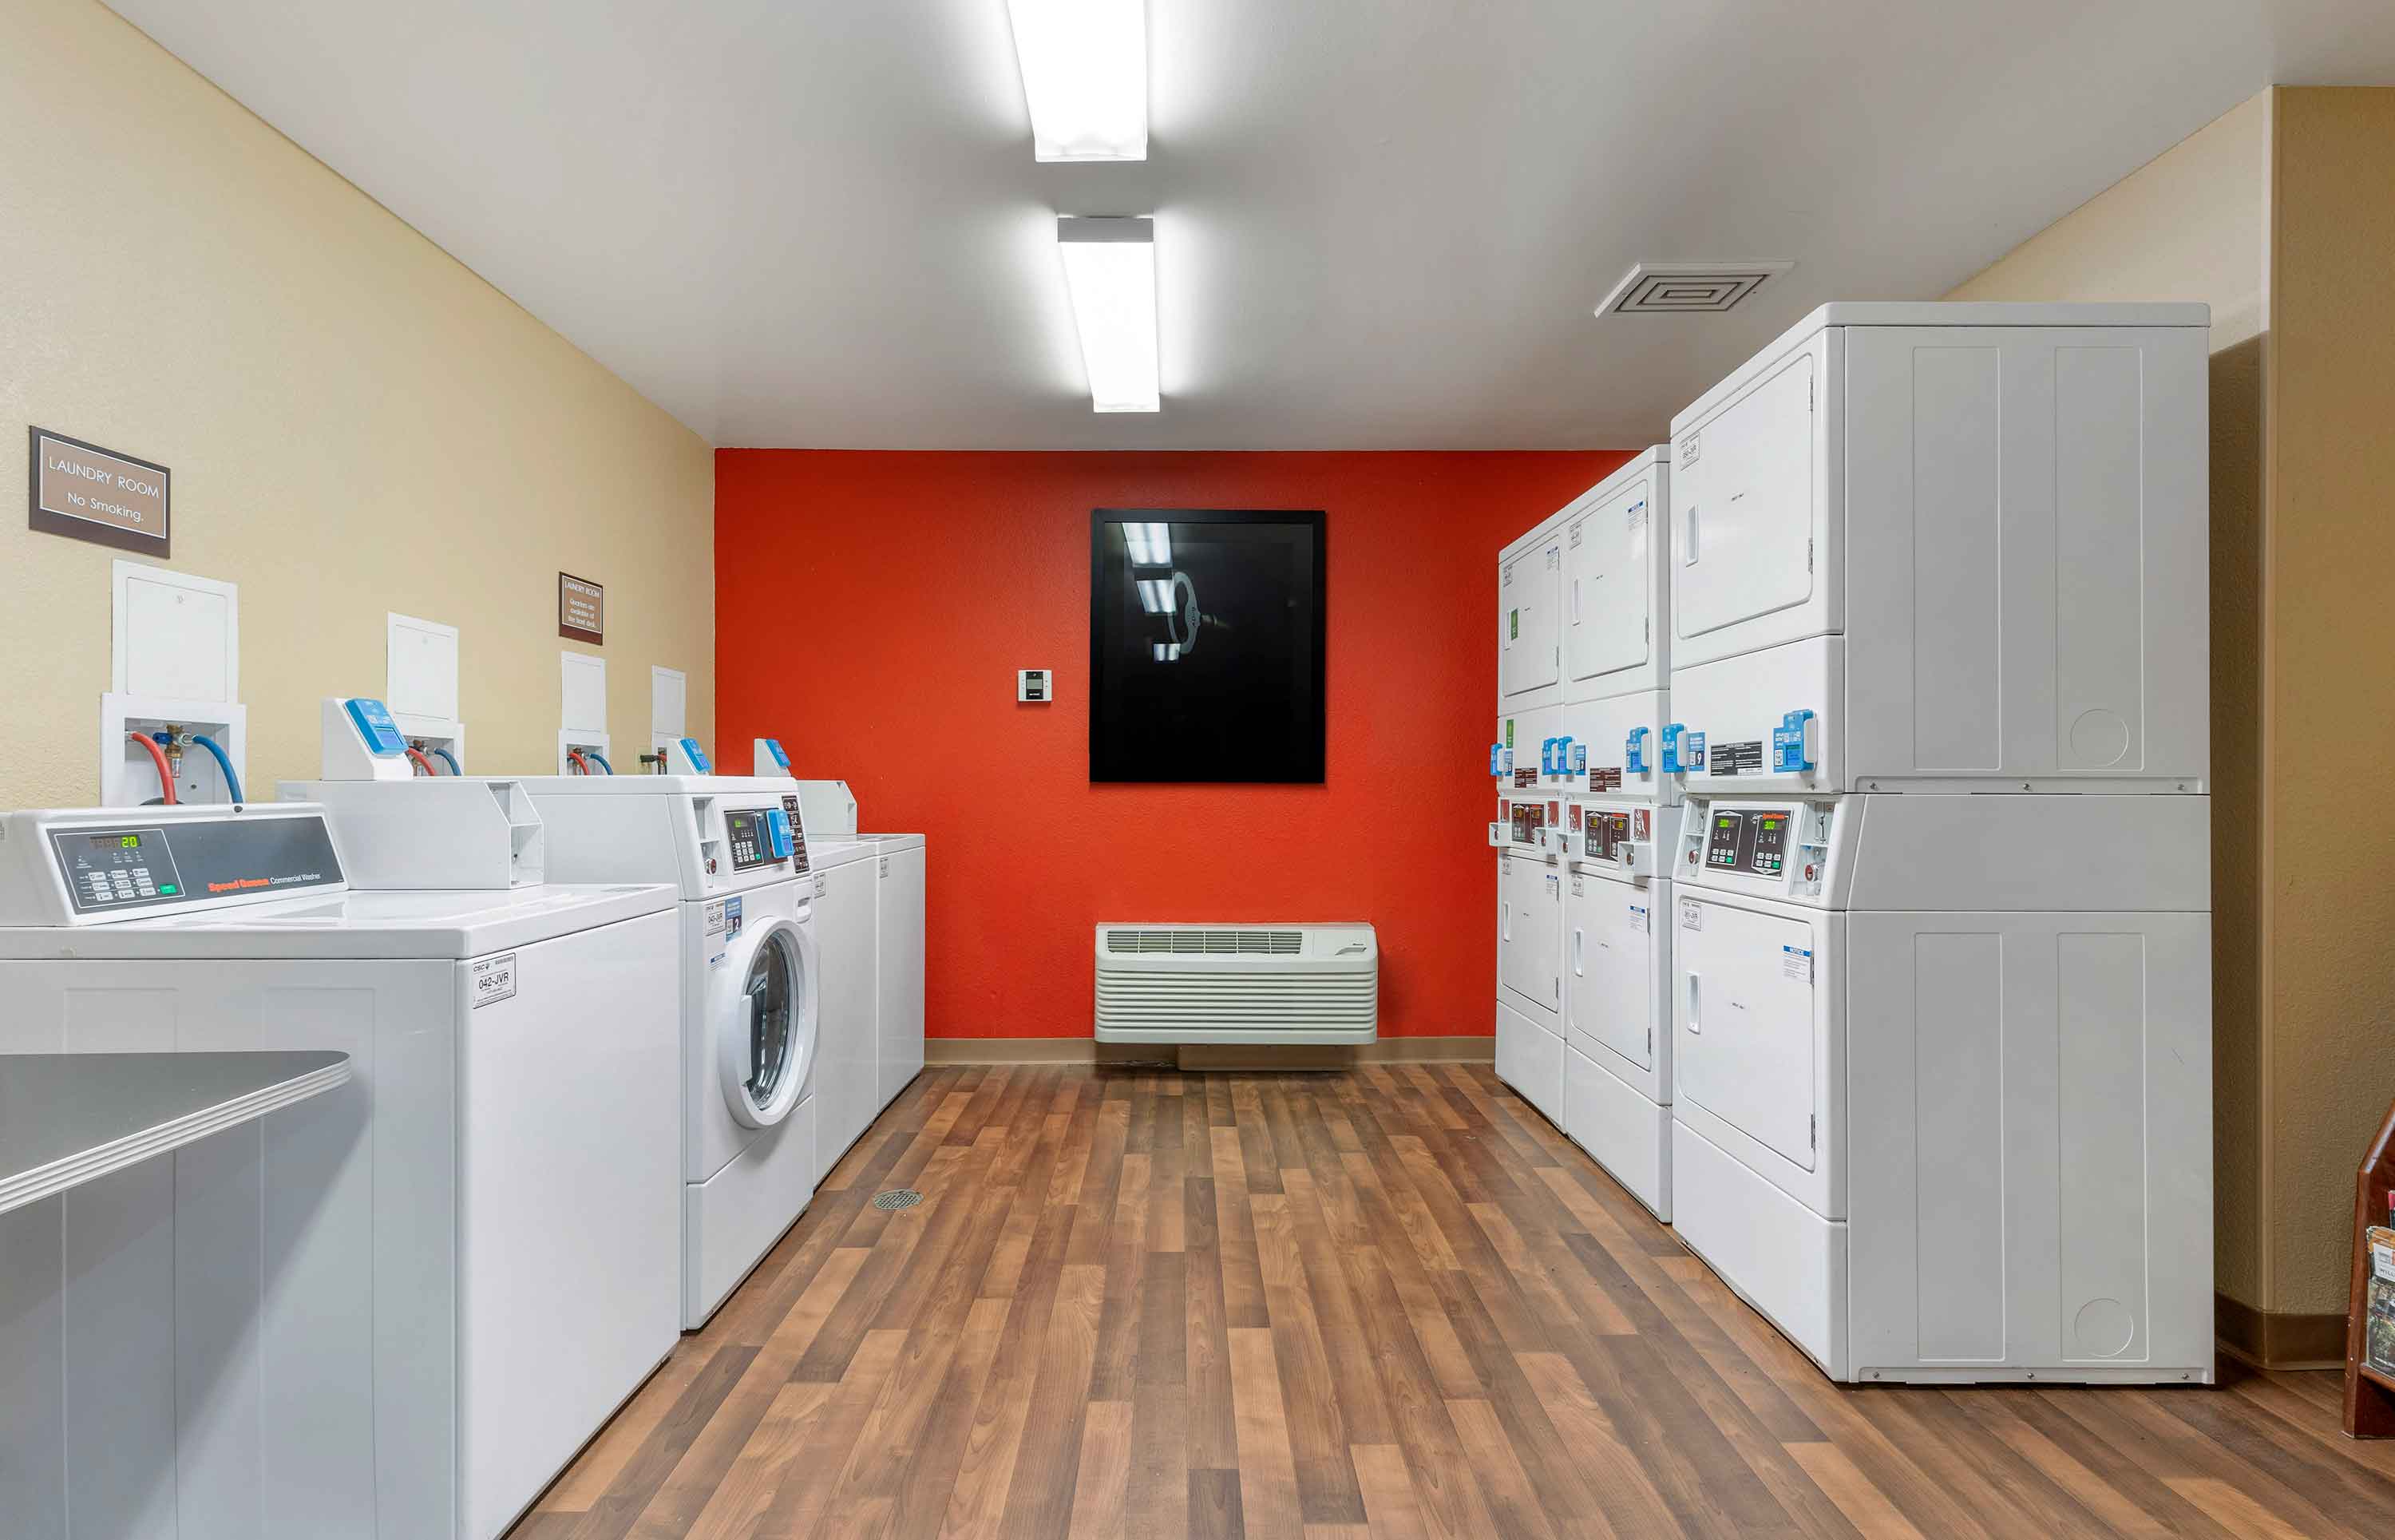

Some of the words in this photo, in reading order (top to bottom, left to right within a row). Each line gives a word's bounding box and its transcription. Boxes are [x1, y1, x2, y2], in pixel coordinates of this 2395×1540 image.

[49, 456, 112, 485] LAUNDRY
[117, 476, 160, 499] ROOM
[67, 492, 85, 506] No
[89, 497, 144, 523] Smoking.
[564, 580, 584, 594] LAUNDRY
[585, 587, 600, 599] ROOM
[121, 837, 139, 849] 20
[208, 878, 240, 893] Speed
[240, 877, 269, 887] Queen
[270, 875, 301, 885] Commercial
[302, 873, 320, 881] Washer
[473, 964, 485, 972] CSC
[478, 972, 509, 990] 042-JVR
